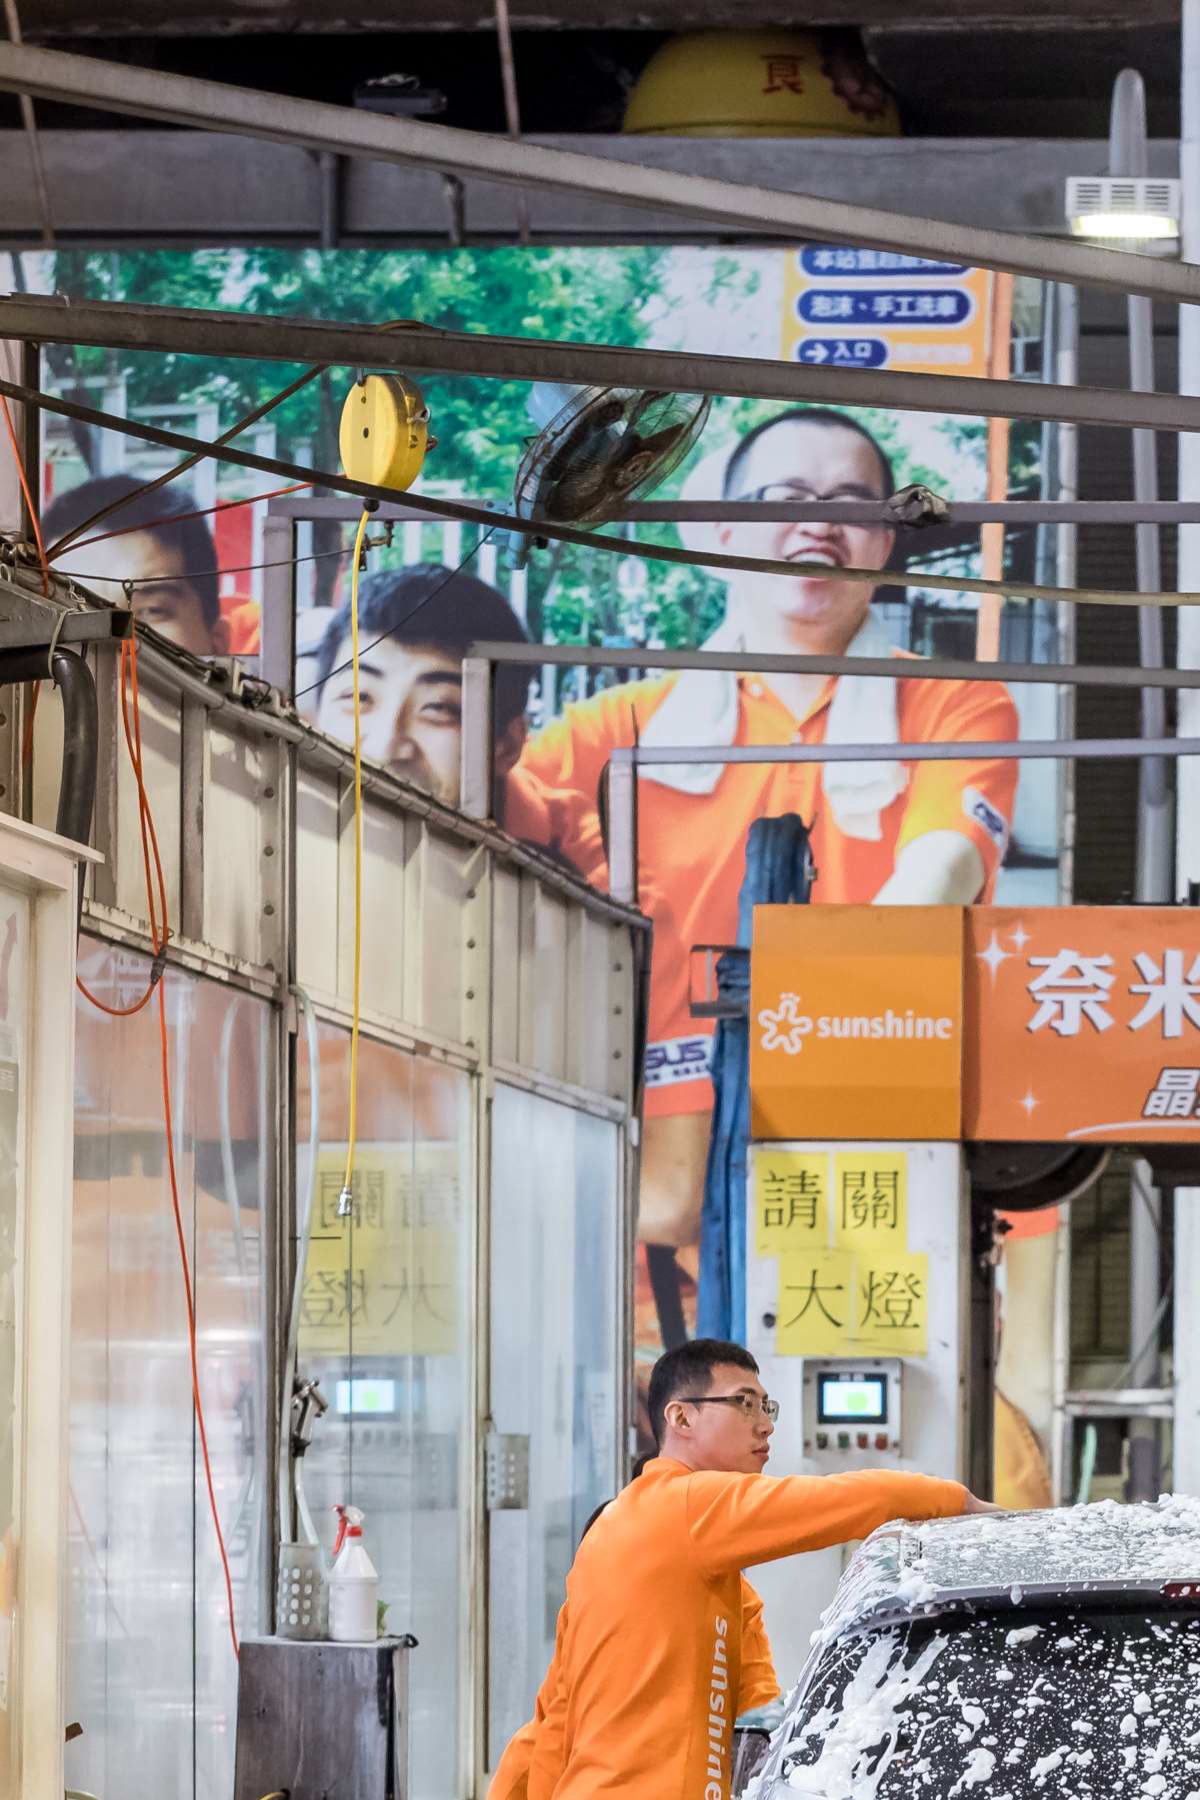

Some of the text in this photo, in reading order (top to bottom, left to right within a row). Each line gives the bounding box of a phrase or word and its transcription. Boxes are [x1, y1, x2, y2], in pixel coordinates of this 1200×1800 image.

[816, 1008, 953, 1041] sunshine
[645, 1039, 706, 1069] SUS
[762, 1170, 899, 1229] 請關
[784, 1268, 921, 1329] 大燈
